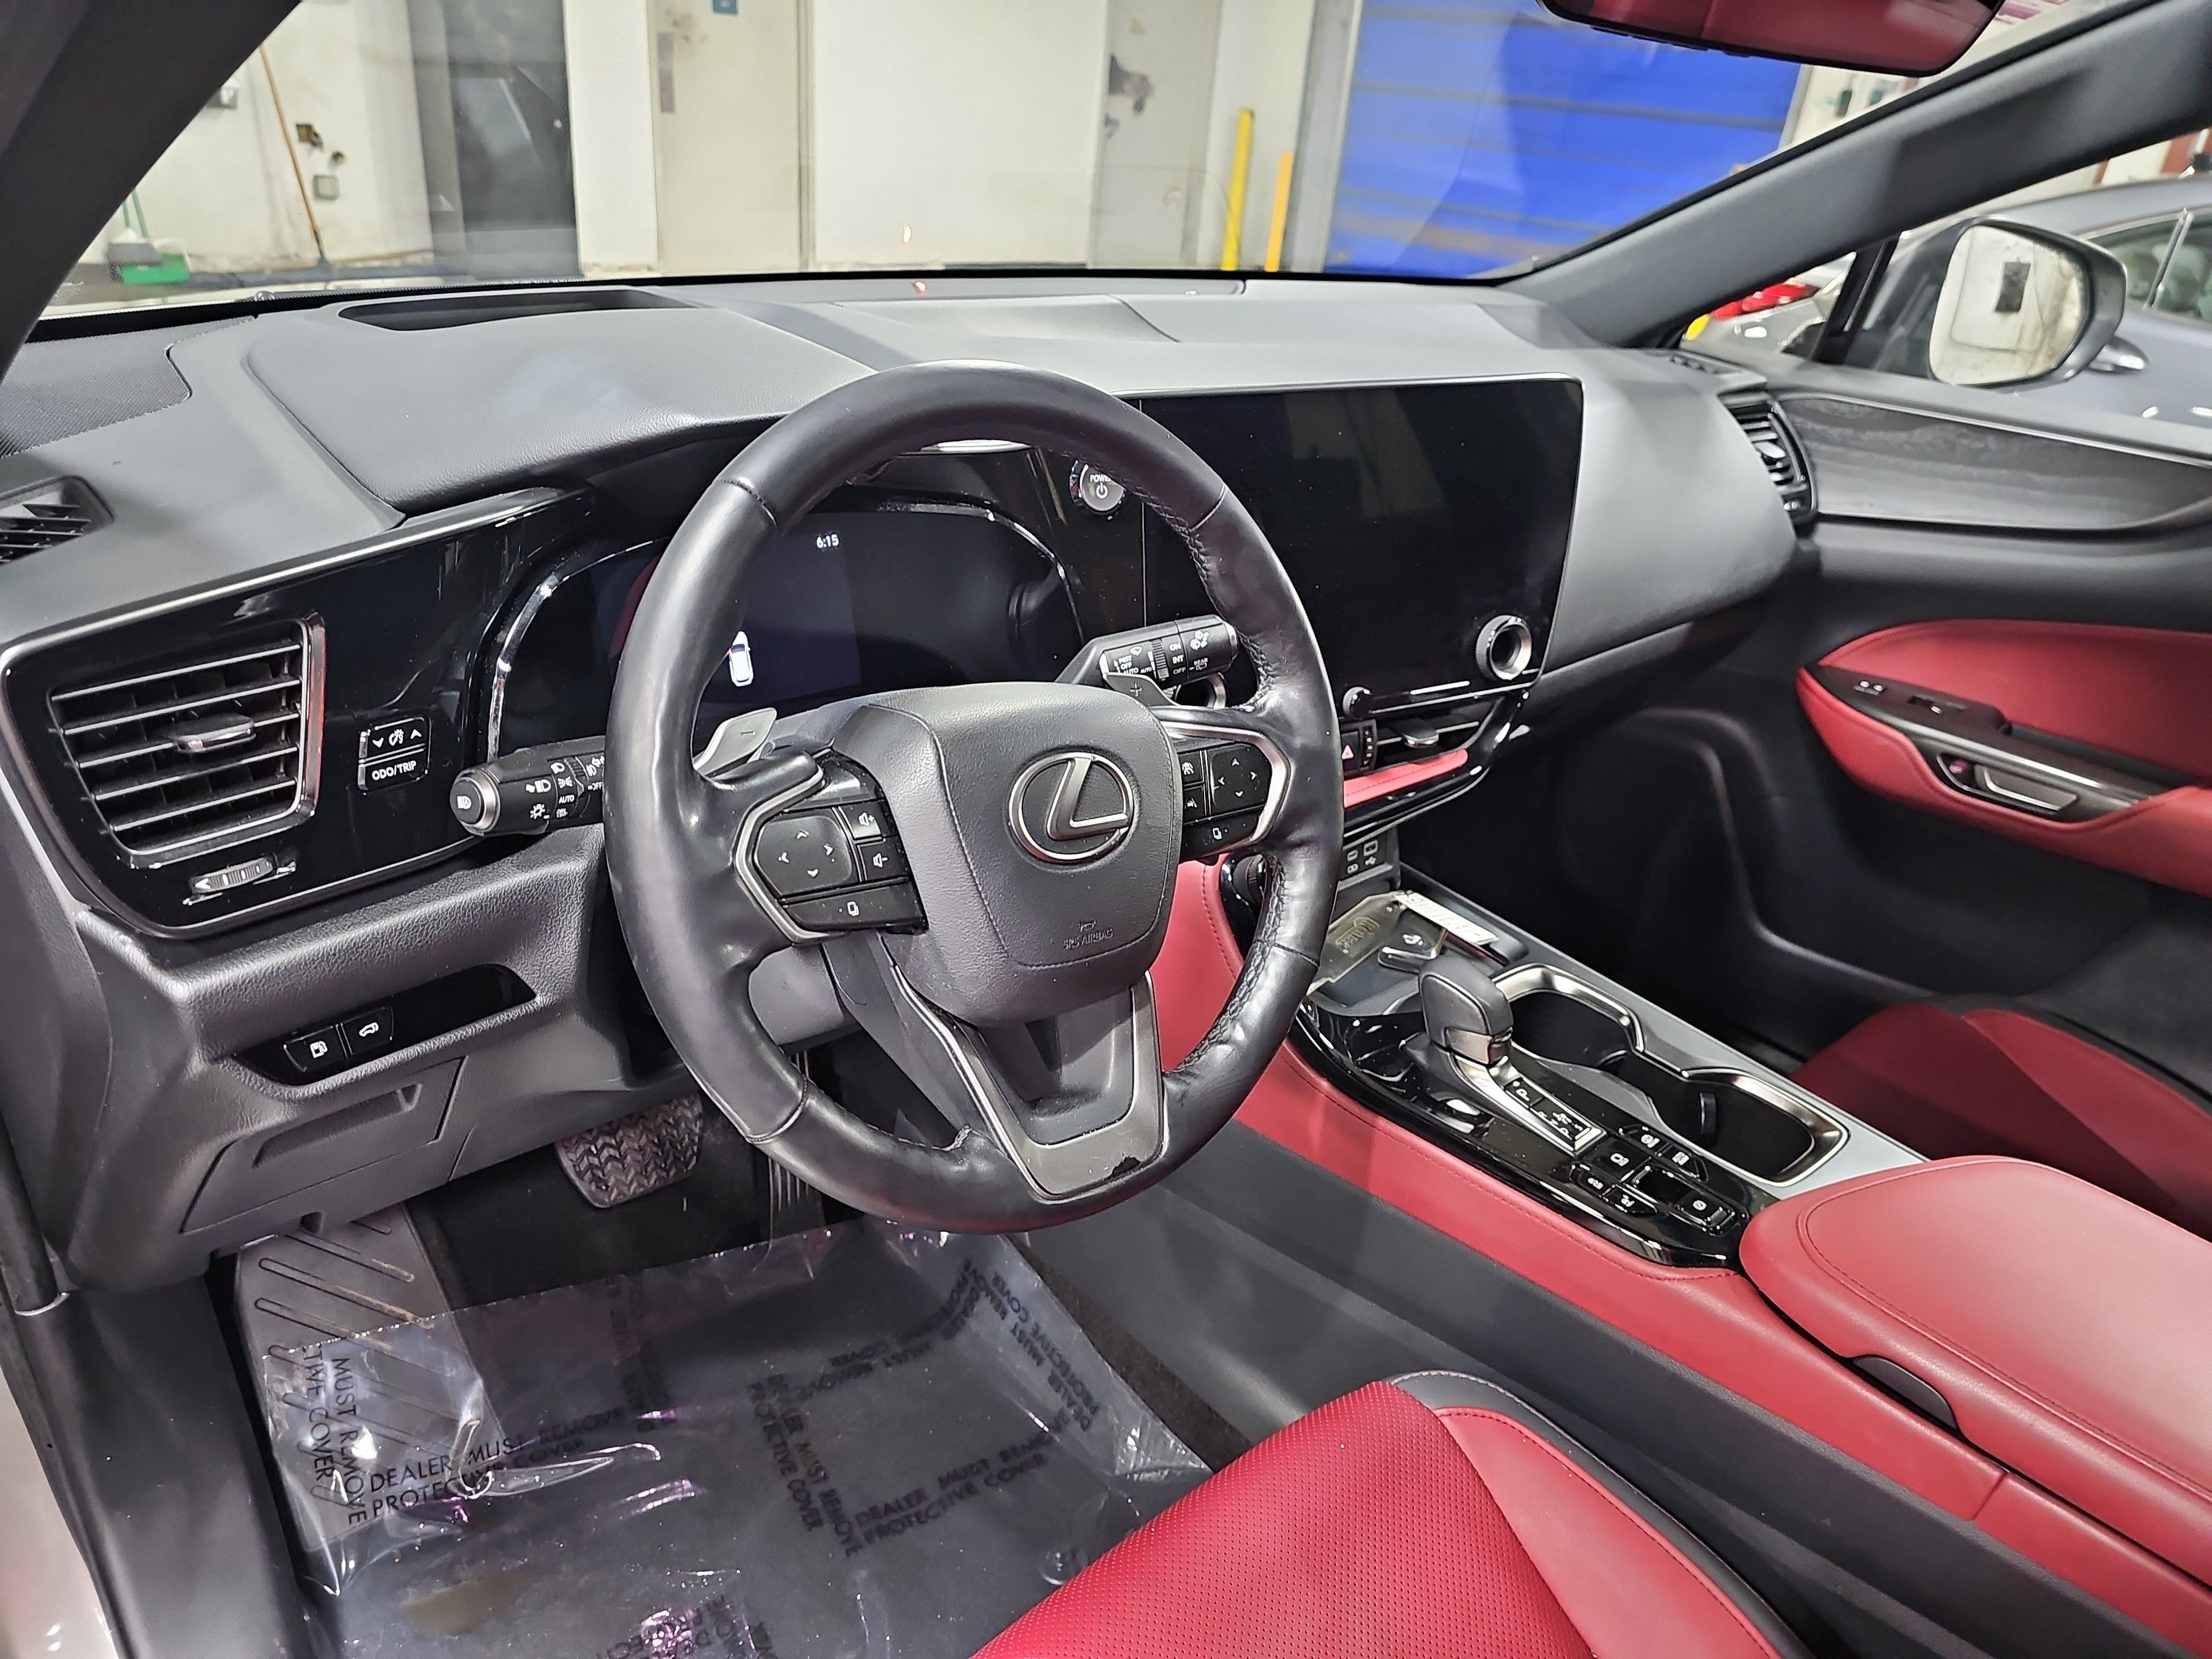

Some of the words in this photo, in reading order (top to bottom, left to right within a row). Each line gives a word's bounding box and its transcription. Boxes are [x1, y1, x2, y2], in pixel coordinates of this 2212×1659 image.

[816, 533, 839, 549] 6:15
[1169, 642, 1181, 651] ON
[1172, 654, 1184, 665] INT
[1194, 657, 1208, 666] REAR
[1120, 662, 1132, 670] OFF
[1173, 666, 1186, 675] OFF
[371, 760, 417, 781] ODO/TRIP
[558, 794, 575, 805] AUTO
[332, 1357, 357, 1416] MUST
[309, 1407, 335, 1481] COVER
[371, 1454, 453, 1493] DEALER
[468, 1435, 524, 1465] MUST
